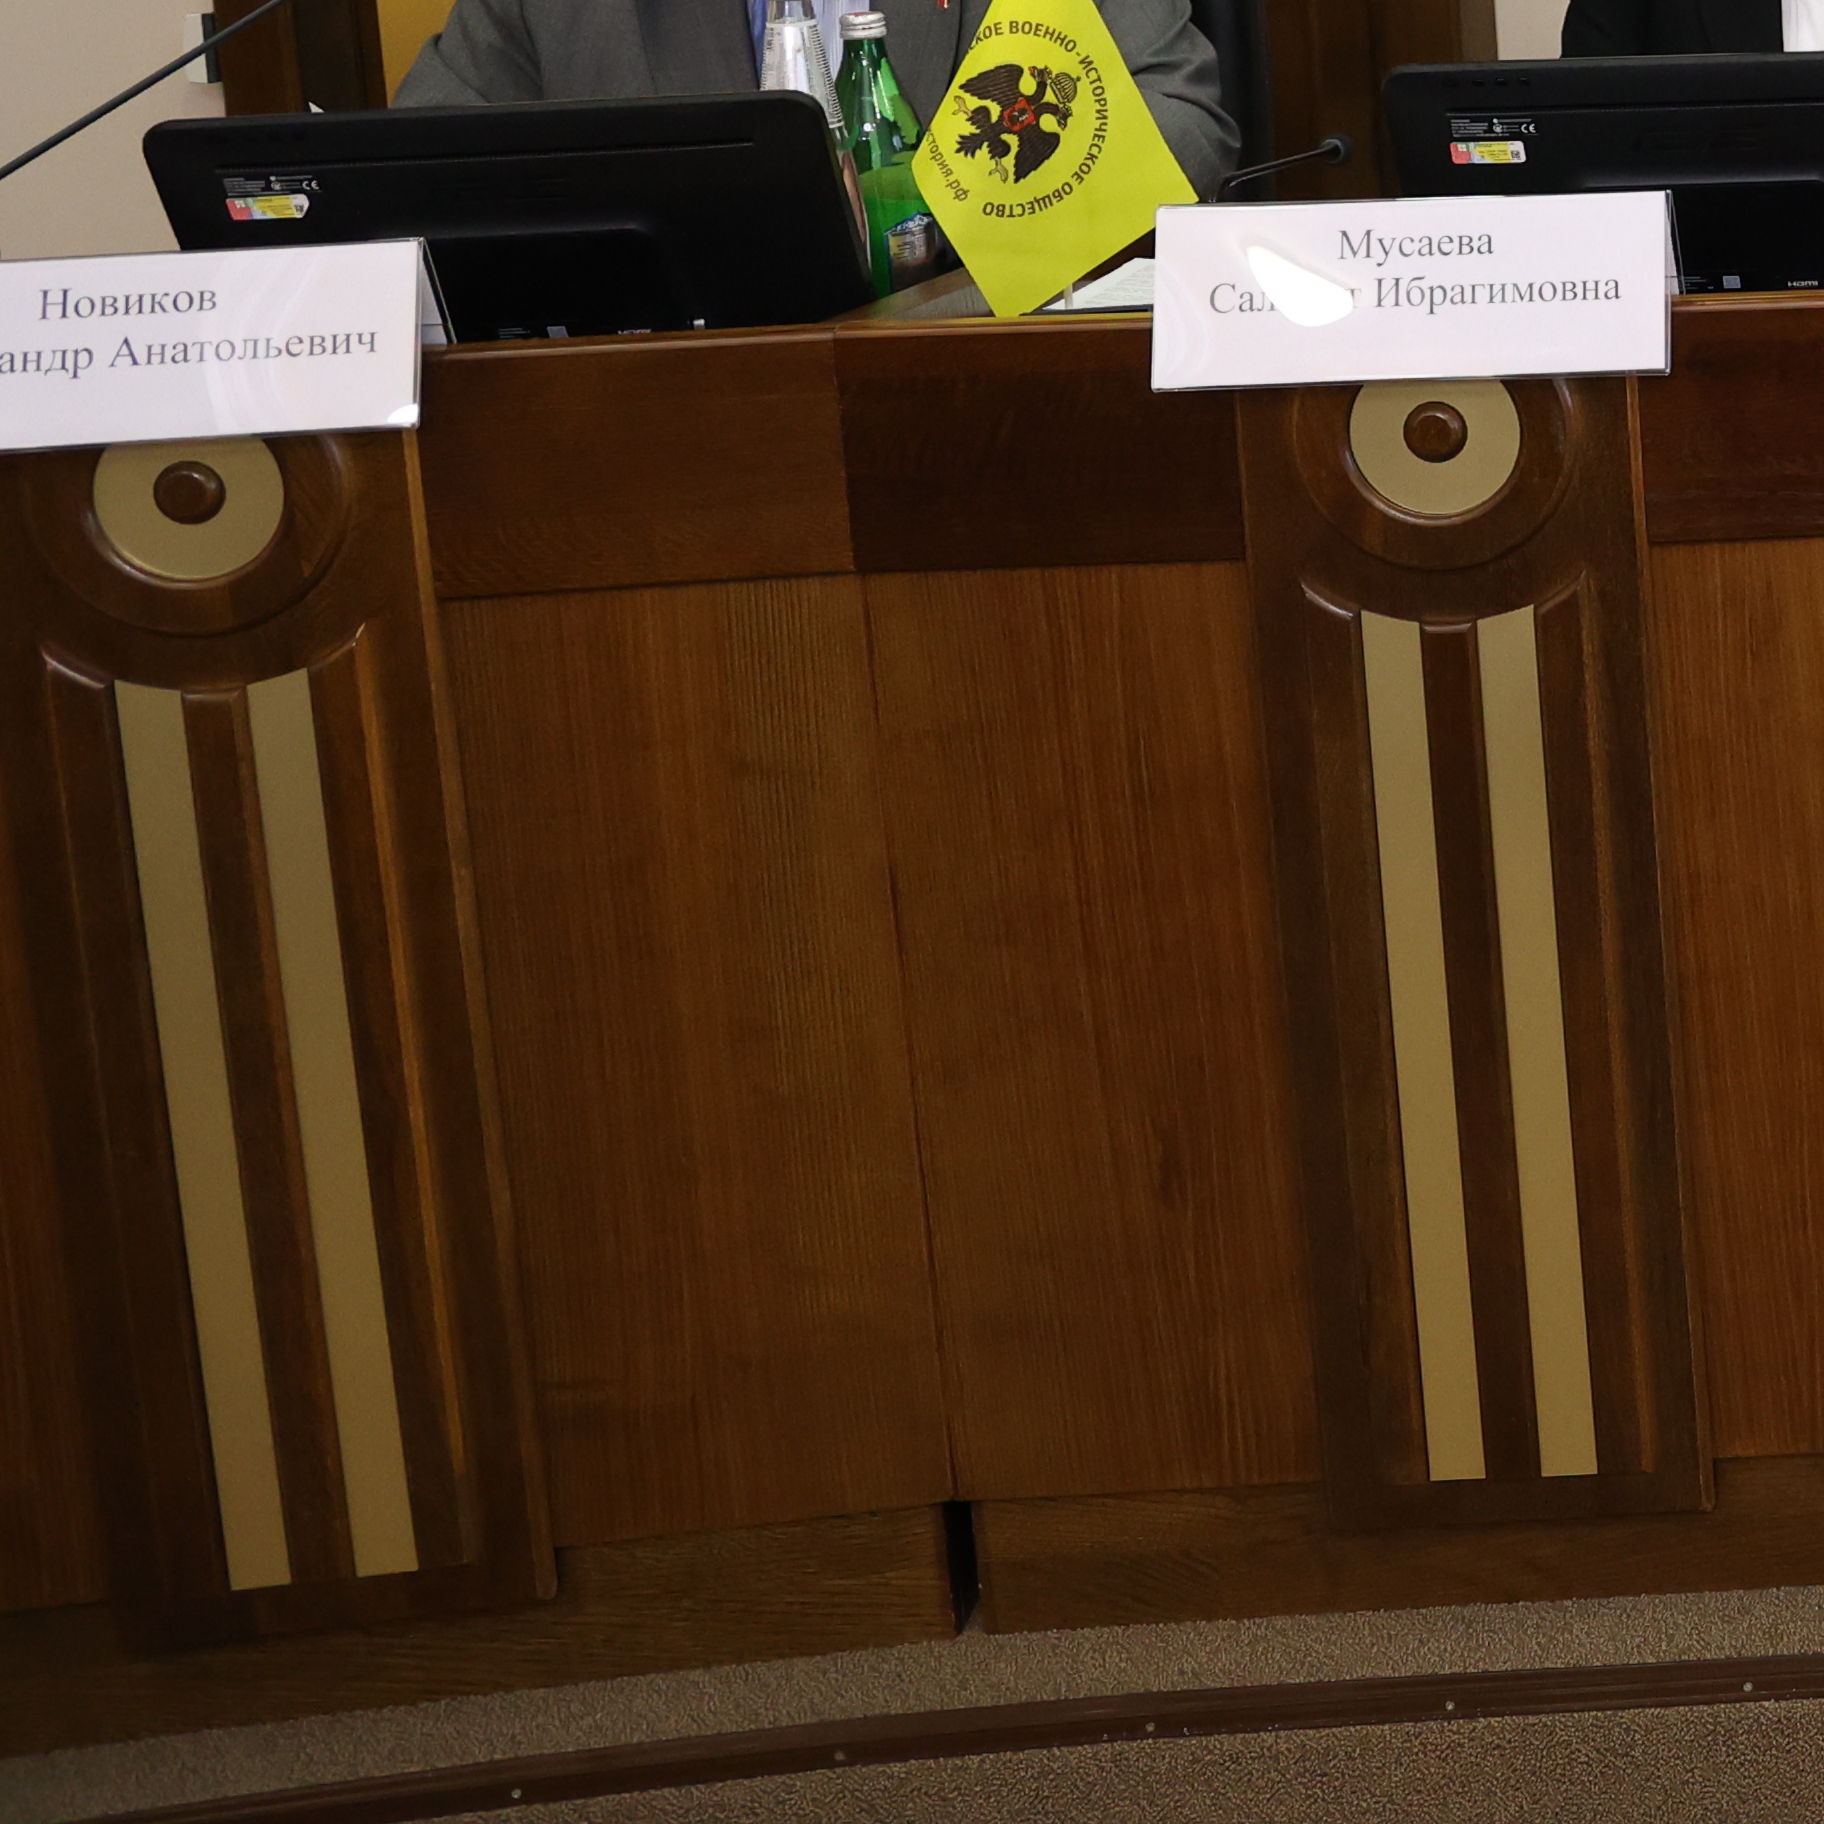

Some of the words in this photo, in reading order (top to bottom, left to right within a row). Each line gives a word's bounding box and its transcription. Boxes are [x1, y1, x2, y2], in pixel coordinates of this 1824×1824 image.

[982, 181, 1074, 218] ОБЩЕСТВО
[1337, 229, 1495, 267] Мусаева
[38, 287, 218, 321] Новиков
[1209, 282, 1362, 314] Салт
[1373, 275, 1622, 316] Ибрагимовна
[108, 332, 378, 369] Анатольевич
